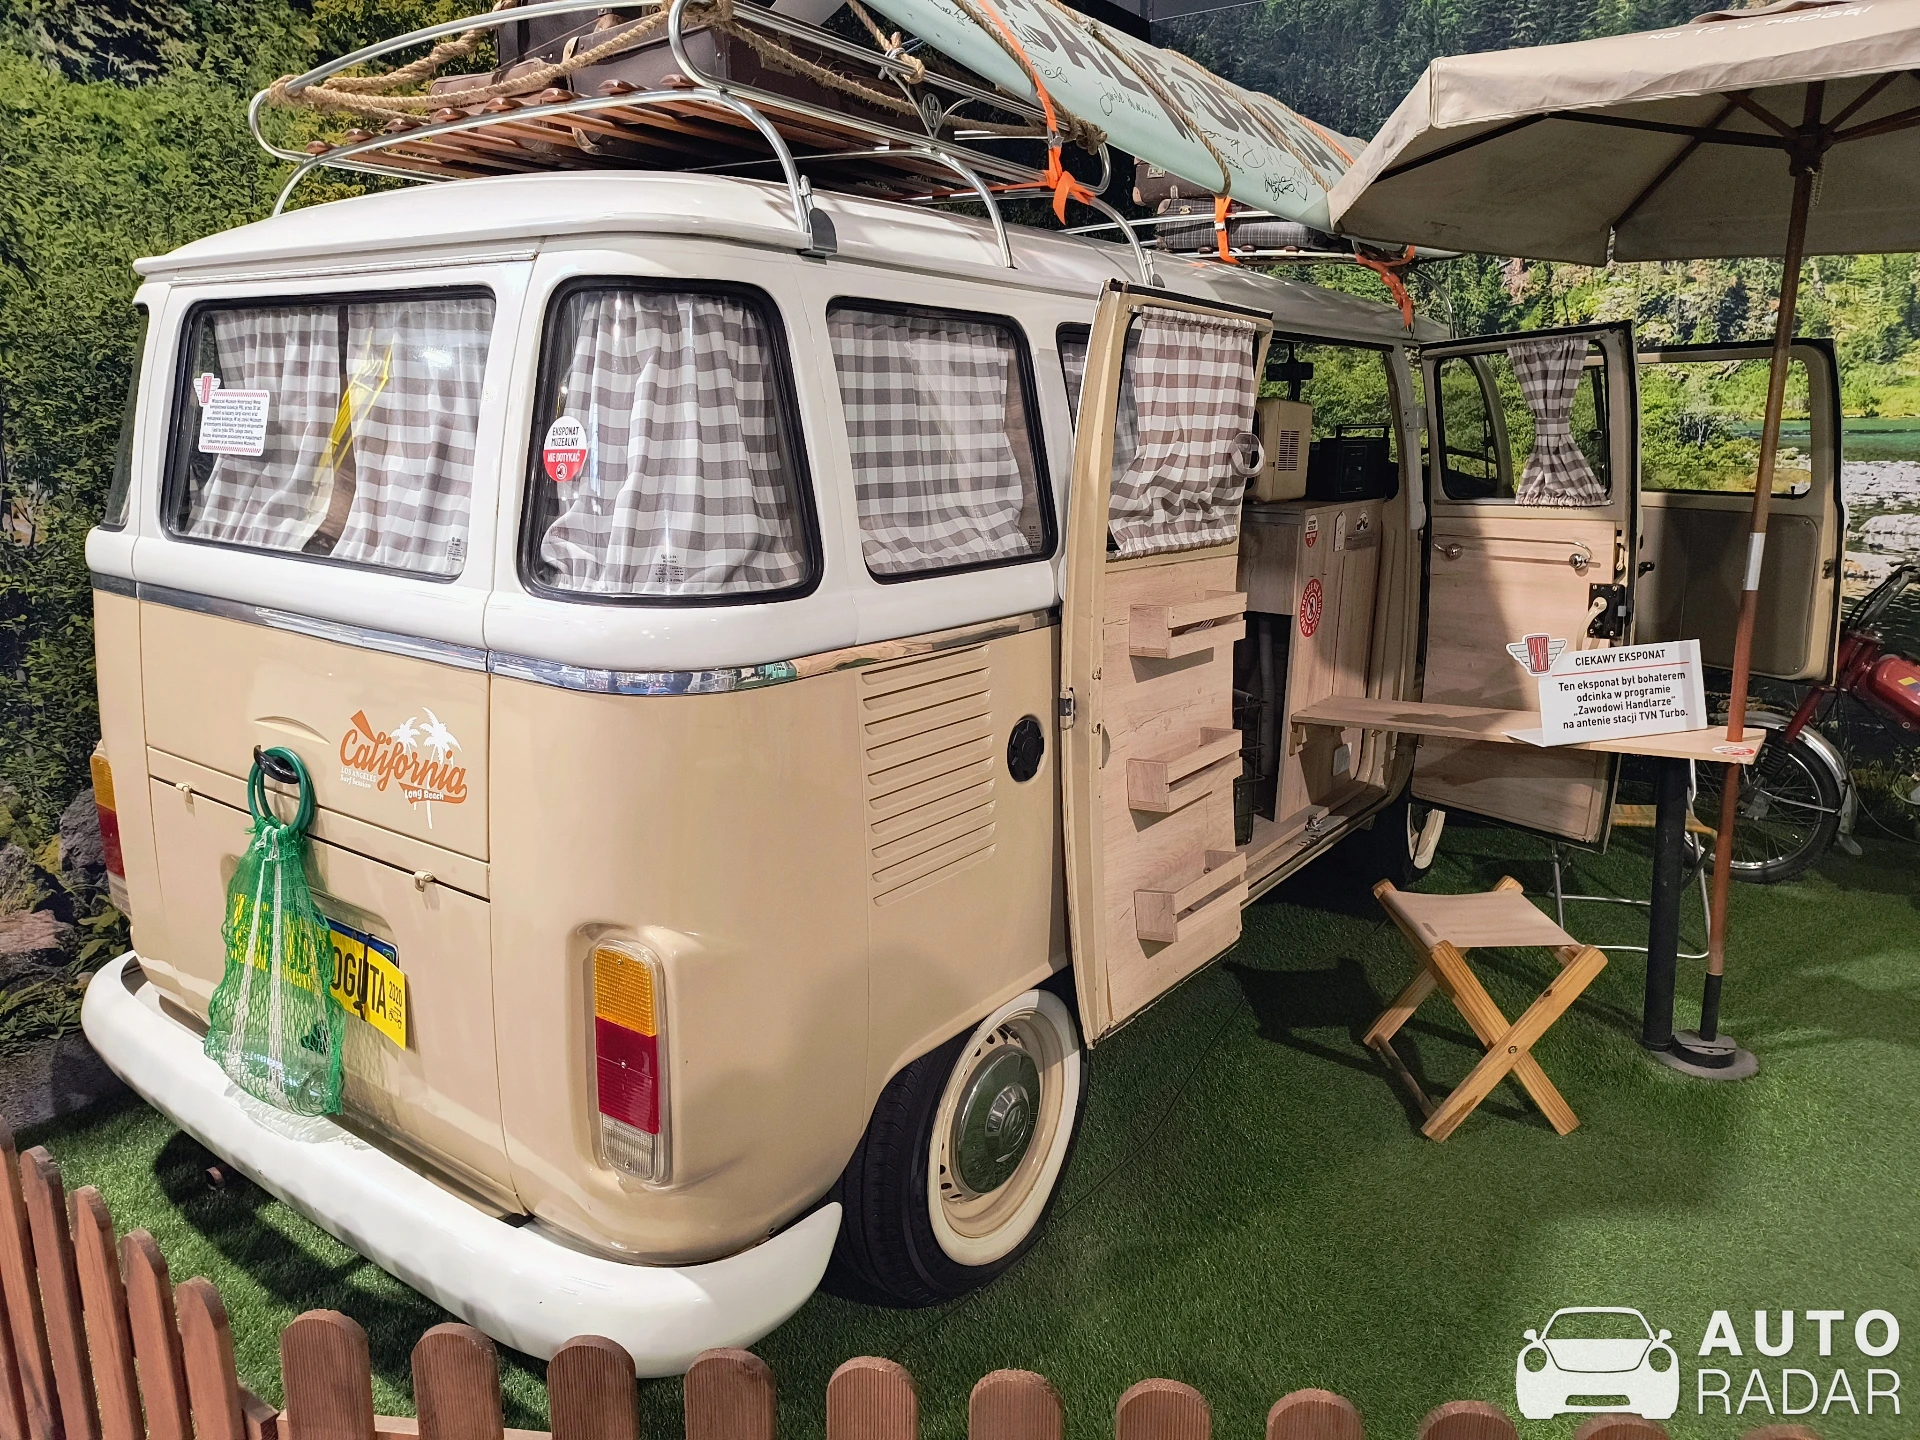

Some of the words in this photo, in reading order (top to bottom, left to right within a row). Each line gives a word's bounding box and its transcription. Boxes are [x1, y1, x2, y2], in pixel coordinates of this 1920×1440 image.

[1648, 32, 1682, 40] NO
[552, 426, 580, 436] EKSPONAT
[551, 437, 579, 447] MUZEALNY
[547, 453, 556, 463] NIE
[556, 450, 581, 463] DOTYKAĆ
[1575, 654, 1617, 667] CIEKAWY
[1619, 649, 1666, 663] EKSPONAT
[1558, 681, 1576, 692] Ten
[1577, 677, 1620, 692] eksponat
[1621, 675, 1636, 687] był
[1637, 671, 1686, 685] bohaterem
[1576, 690, 1612, 703] odcinka
[1613, 691, 1623, 700] w
[1624, 685, 1671, 702] programie
[1563, 720, 1575, 730] na
[1576, 716, 1611, 728] antenie
[1613, 713, 1638, 726] stacji
[1638, 710, 1658, 722] TVN
[1659, 707, 1689, 719] Turbo.
[340, 710, 467, 795] California
[339, 774, 352, 786] Surf
[341, 766, 352, 776] LOS
[352, 770, 377, 783] ANGELES
[404, 789, 423, 800] Long
[424, 790, 444, 801] Beach
[330, 946, 387, 1019] OGUTA
[389, 981, 402, 1007] 2020
